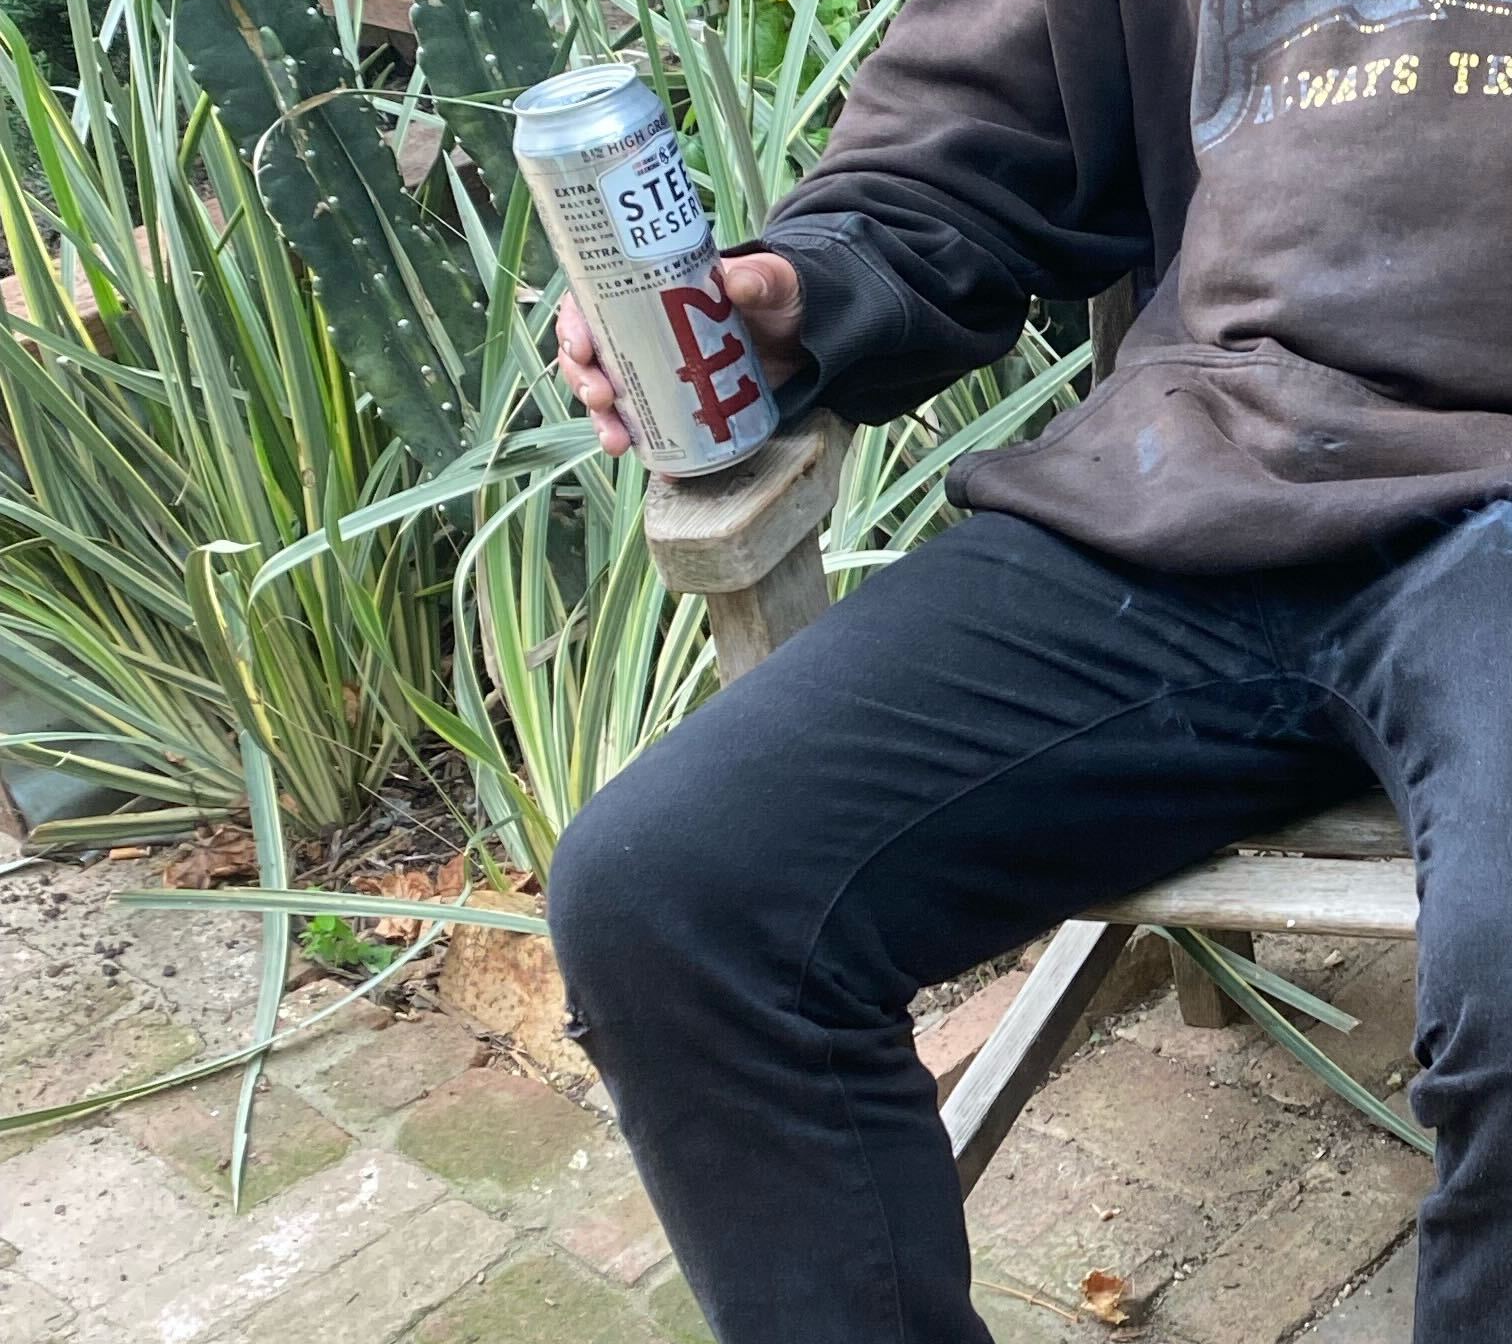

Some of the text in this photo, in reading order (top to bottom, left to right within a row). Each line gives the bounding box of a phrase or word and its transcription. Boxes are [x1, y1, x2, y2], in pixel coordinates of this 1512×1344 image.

[607, 129, 645, 155] HIGH
[554, 183, 596, 197] EXTRA
[618, 158, 692, 222] STEE
[630, 196, 701, 248] RESER
[579, 246, 620, 260] EXTRA
[597, 277, 634, 290] SLOW
